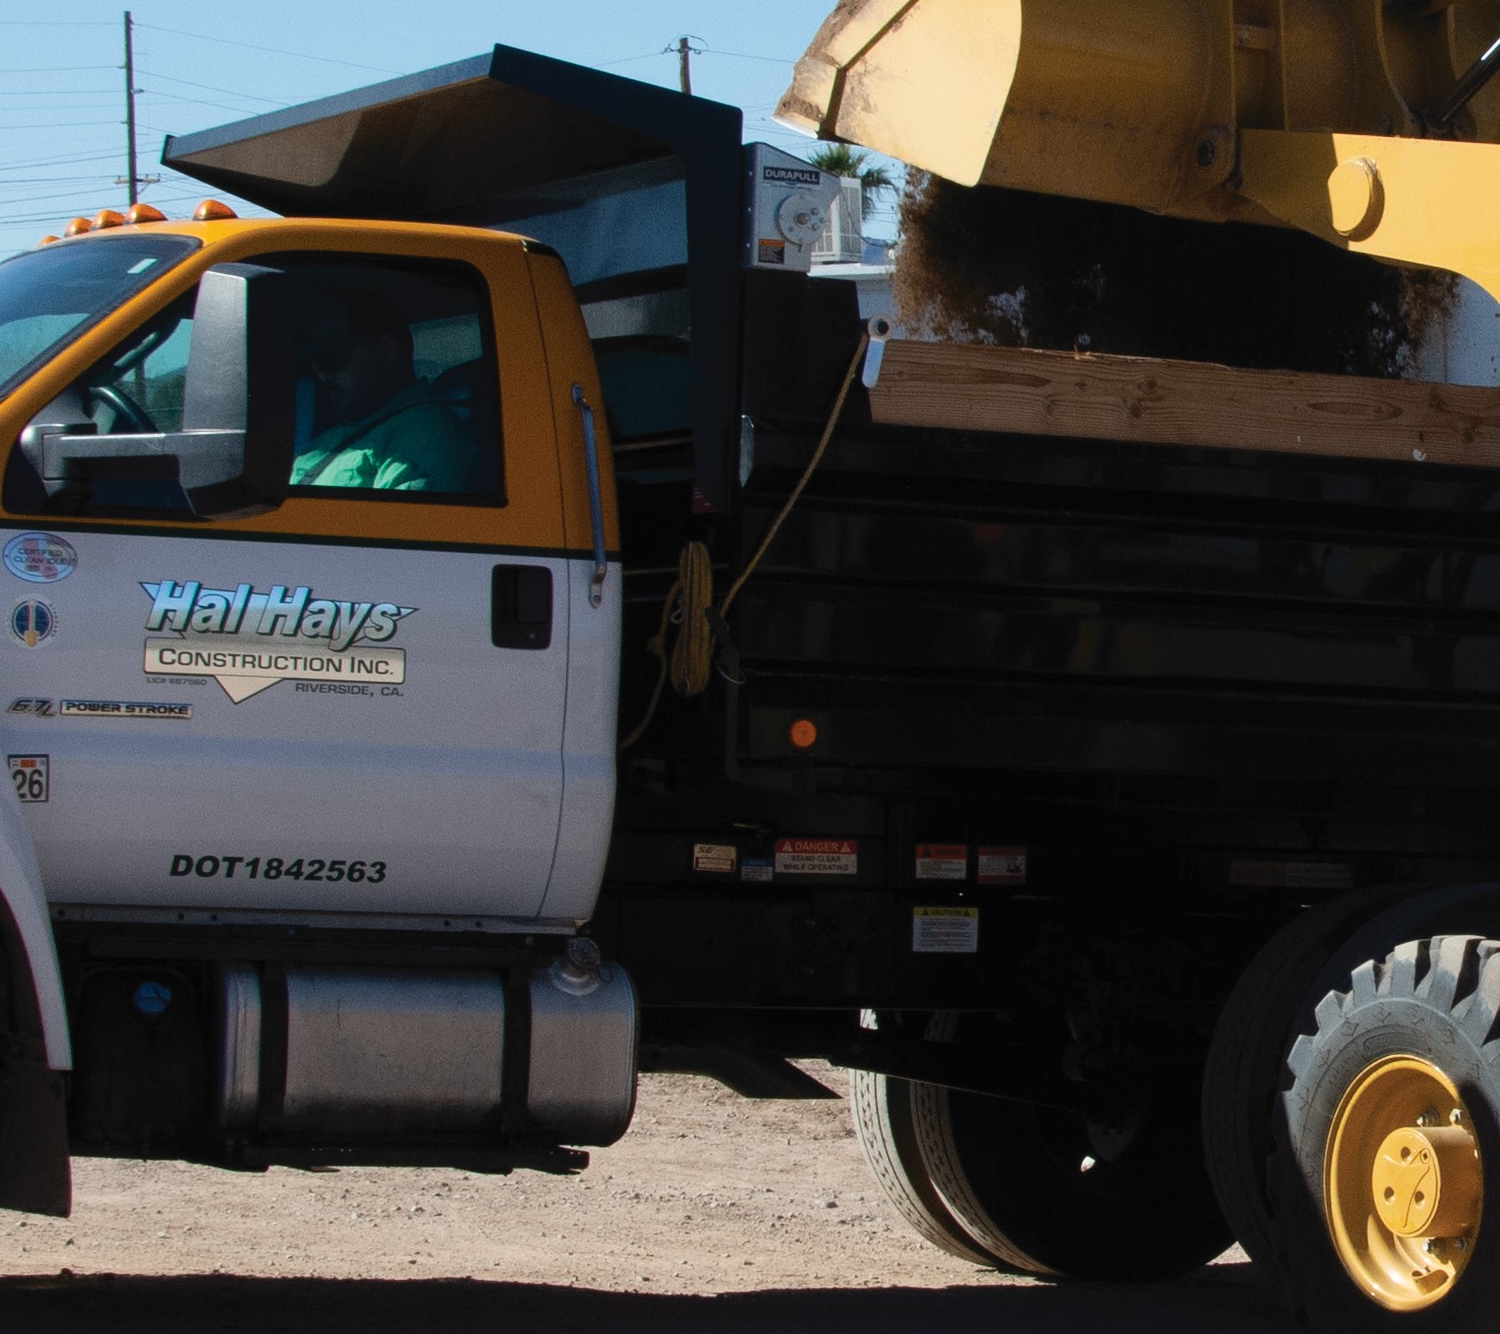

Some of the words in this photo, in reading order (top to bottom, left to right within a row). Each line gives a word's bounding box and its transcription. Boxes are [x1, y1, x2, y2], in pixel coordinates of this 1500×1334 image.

[764, 169, 818, 182] DURAPULL
[144, 579, 254, 634] Hal
[256, 584, 403, 652] Hays
[158, 647, 342, 674] CONSTRUCTION
[349, 655, 395, 676] INC.
[295, 683, 375, 697] RIVERSIDE,
[380, 686, 405, 698] CA.
[65, 702, 121, 713] POWER
[125, 704, 190, 715] STROKE
[11, 768, 45, 800] 26
[794, 841, 839, 852] DANGER
[168, 853, 388, 884] DOT1842563
